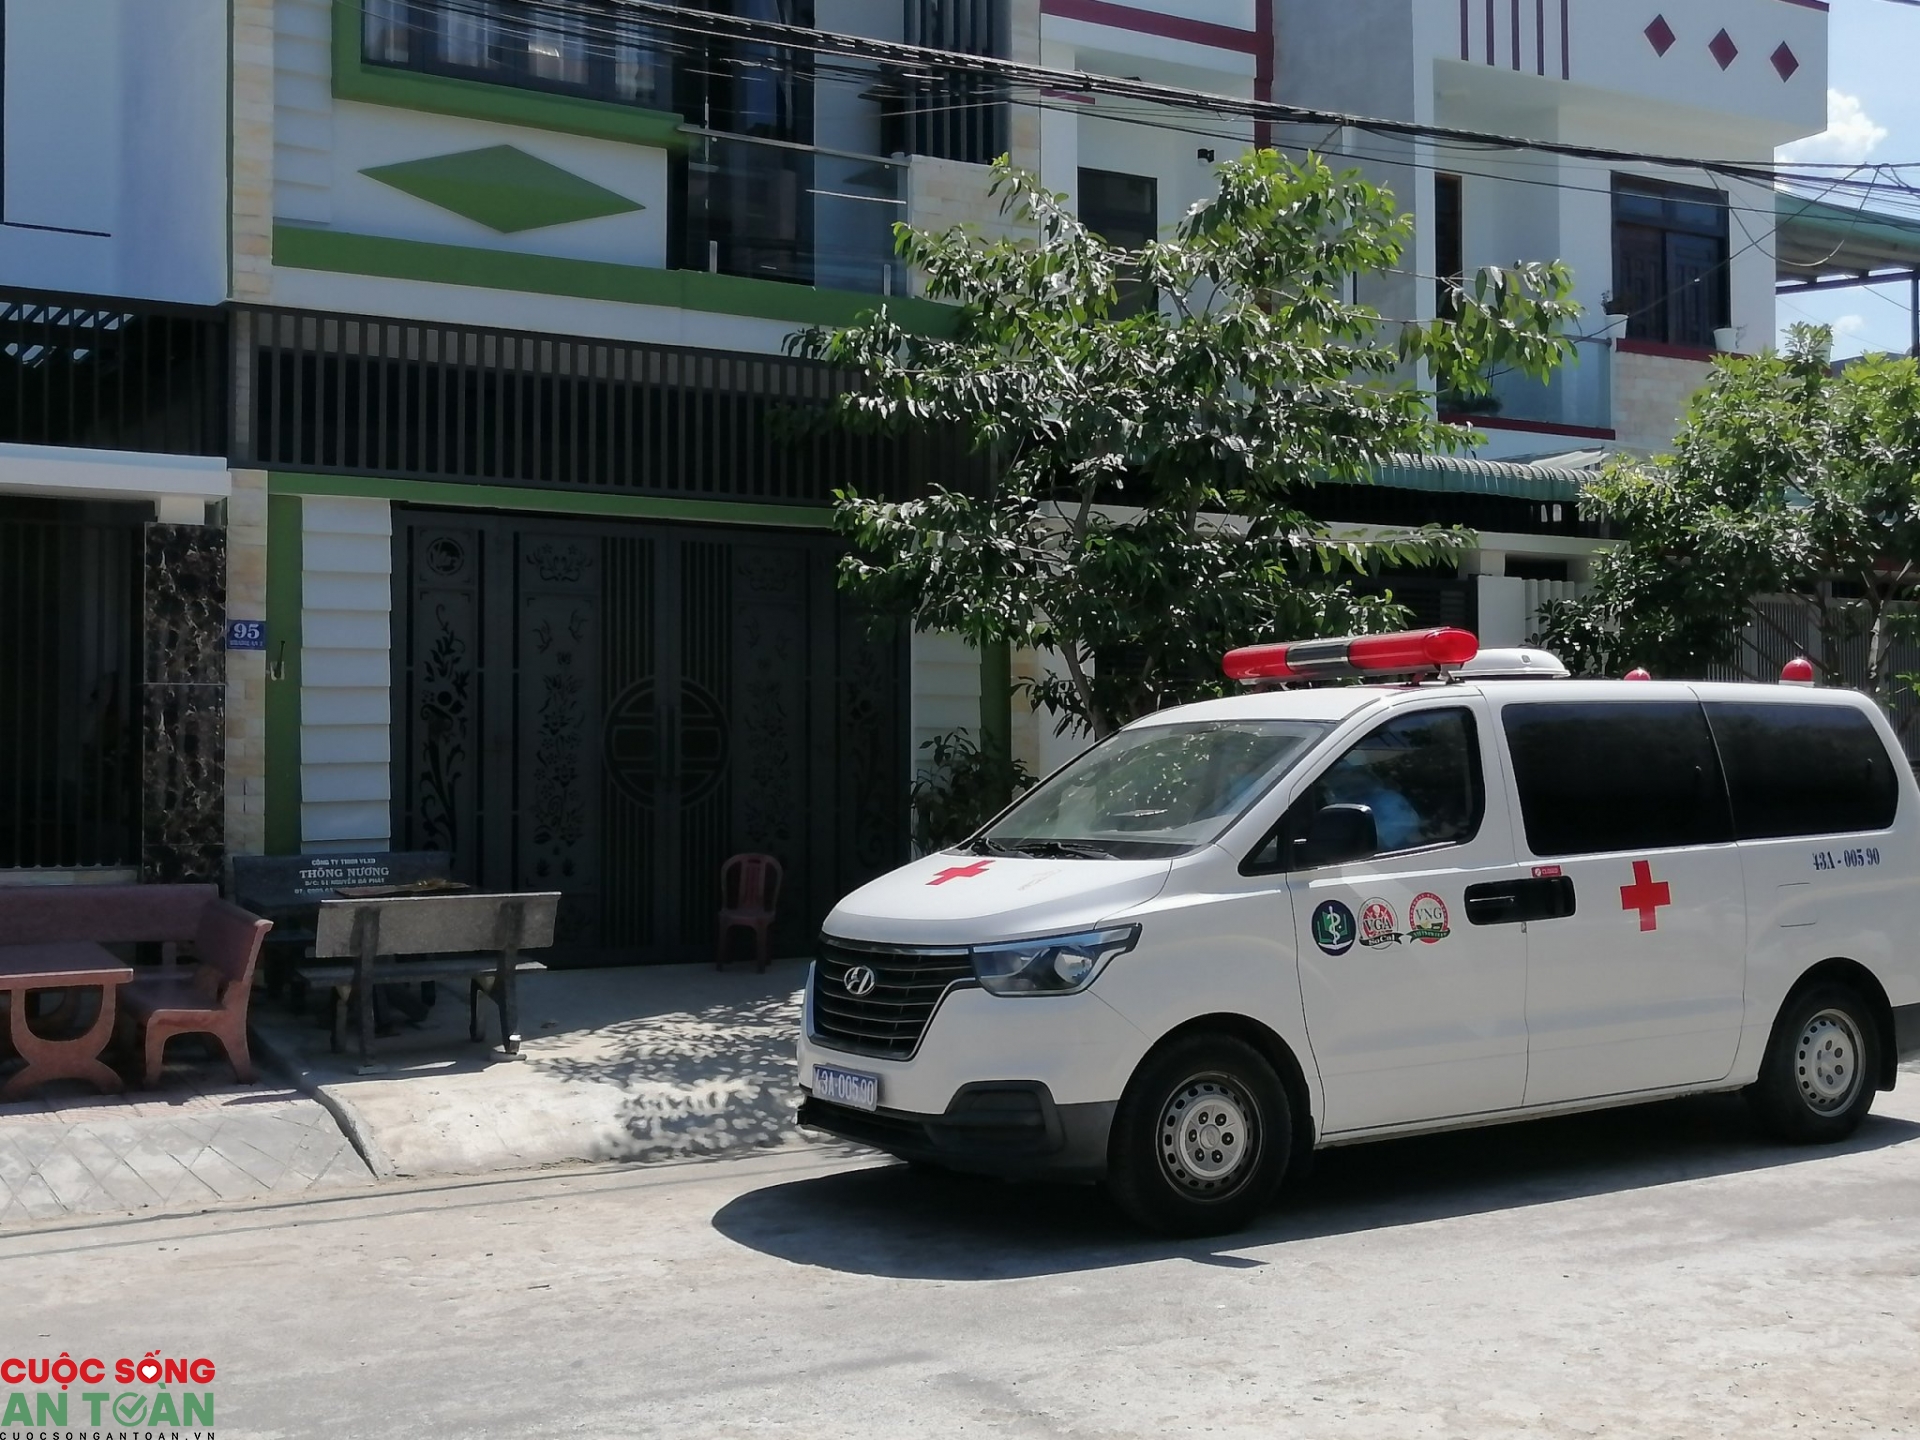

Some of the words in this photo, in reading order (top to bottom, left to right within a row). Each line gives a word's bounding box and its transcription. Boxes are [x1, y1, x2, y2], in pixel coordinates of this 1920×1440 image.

[233, 623, 260, 639] 95
[1416, 907, 1442, 920] VNG
[1364, 919, 1392, 930] VGA
